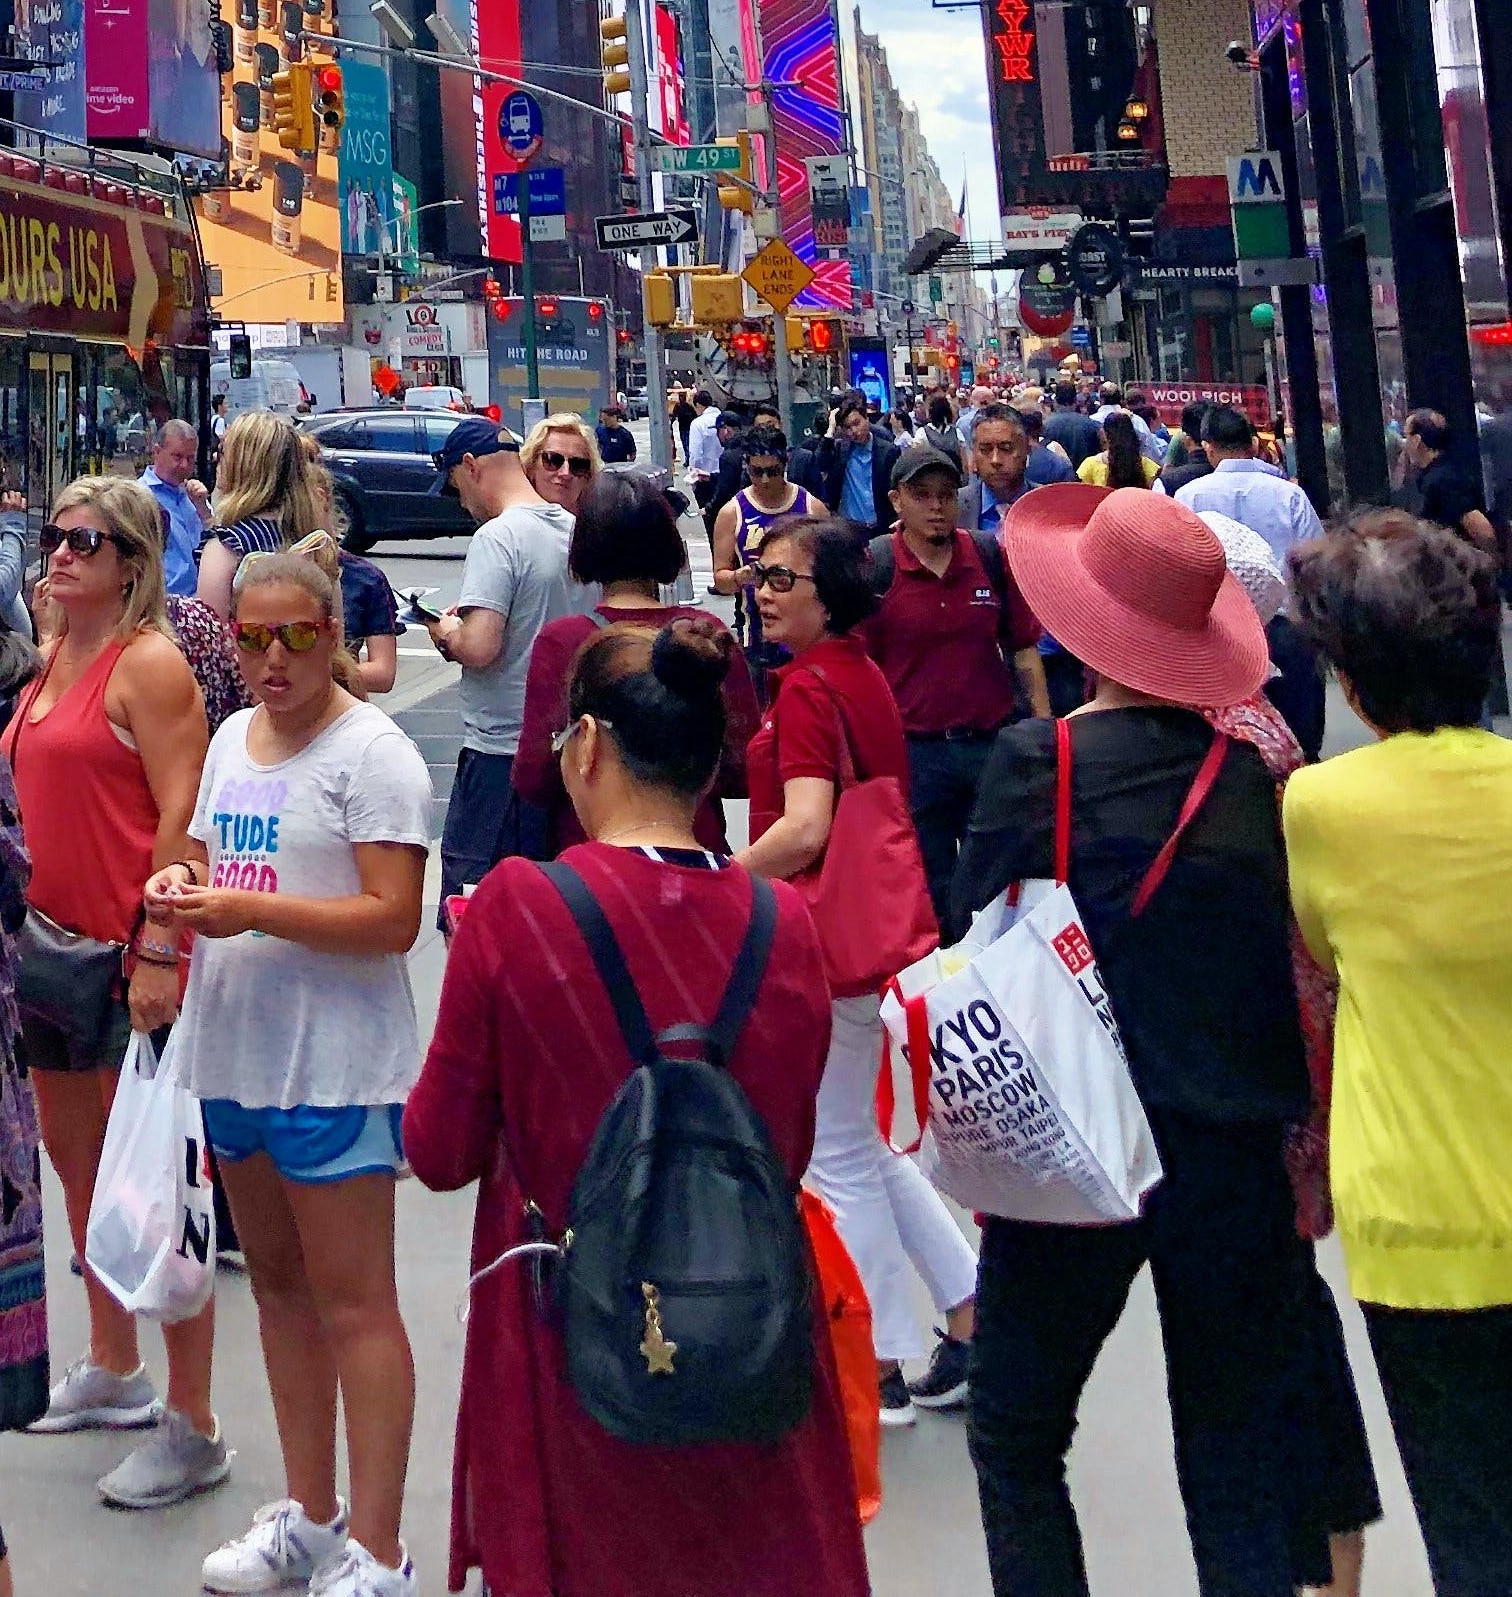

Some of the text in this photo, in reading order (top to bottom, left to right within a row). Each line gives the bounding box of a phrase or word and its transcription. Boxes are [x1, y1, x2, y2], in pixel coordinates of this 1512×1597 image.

[106, 94, 135, 104] video
[346, 128, 387, 165] MSG
[696, 149, 719, 167] 49
[723, 148, 736, 159] ST
[495, 195, 518, 212] M104
[611, 221, 682, 240] ONE WAY
[69, 225, 118, 314] USA
[760, 255, 794, 266] RIGHT
[762, 270, 794, 281] LANE
[1141, 267, 1189, 278] HEARTY
[763, 284, 795, 295] ENDS
[408, 332, 443, 346] COMEDY
[507, 347, 588, 361] HIT HE ROAD
[213, 812, 280, 853] 'TUDE
[928, 998, 1002, 1073] KYO
[933, 1039, 1024, 1107] PARIS
[941, 1067, 1040, 1130] MOSCOW
[996, 1093, 1052, 1133] OSAKA
[1019, 1111, 1060, 1141] TAIPEI
